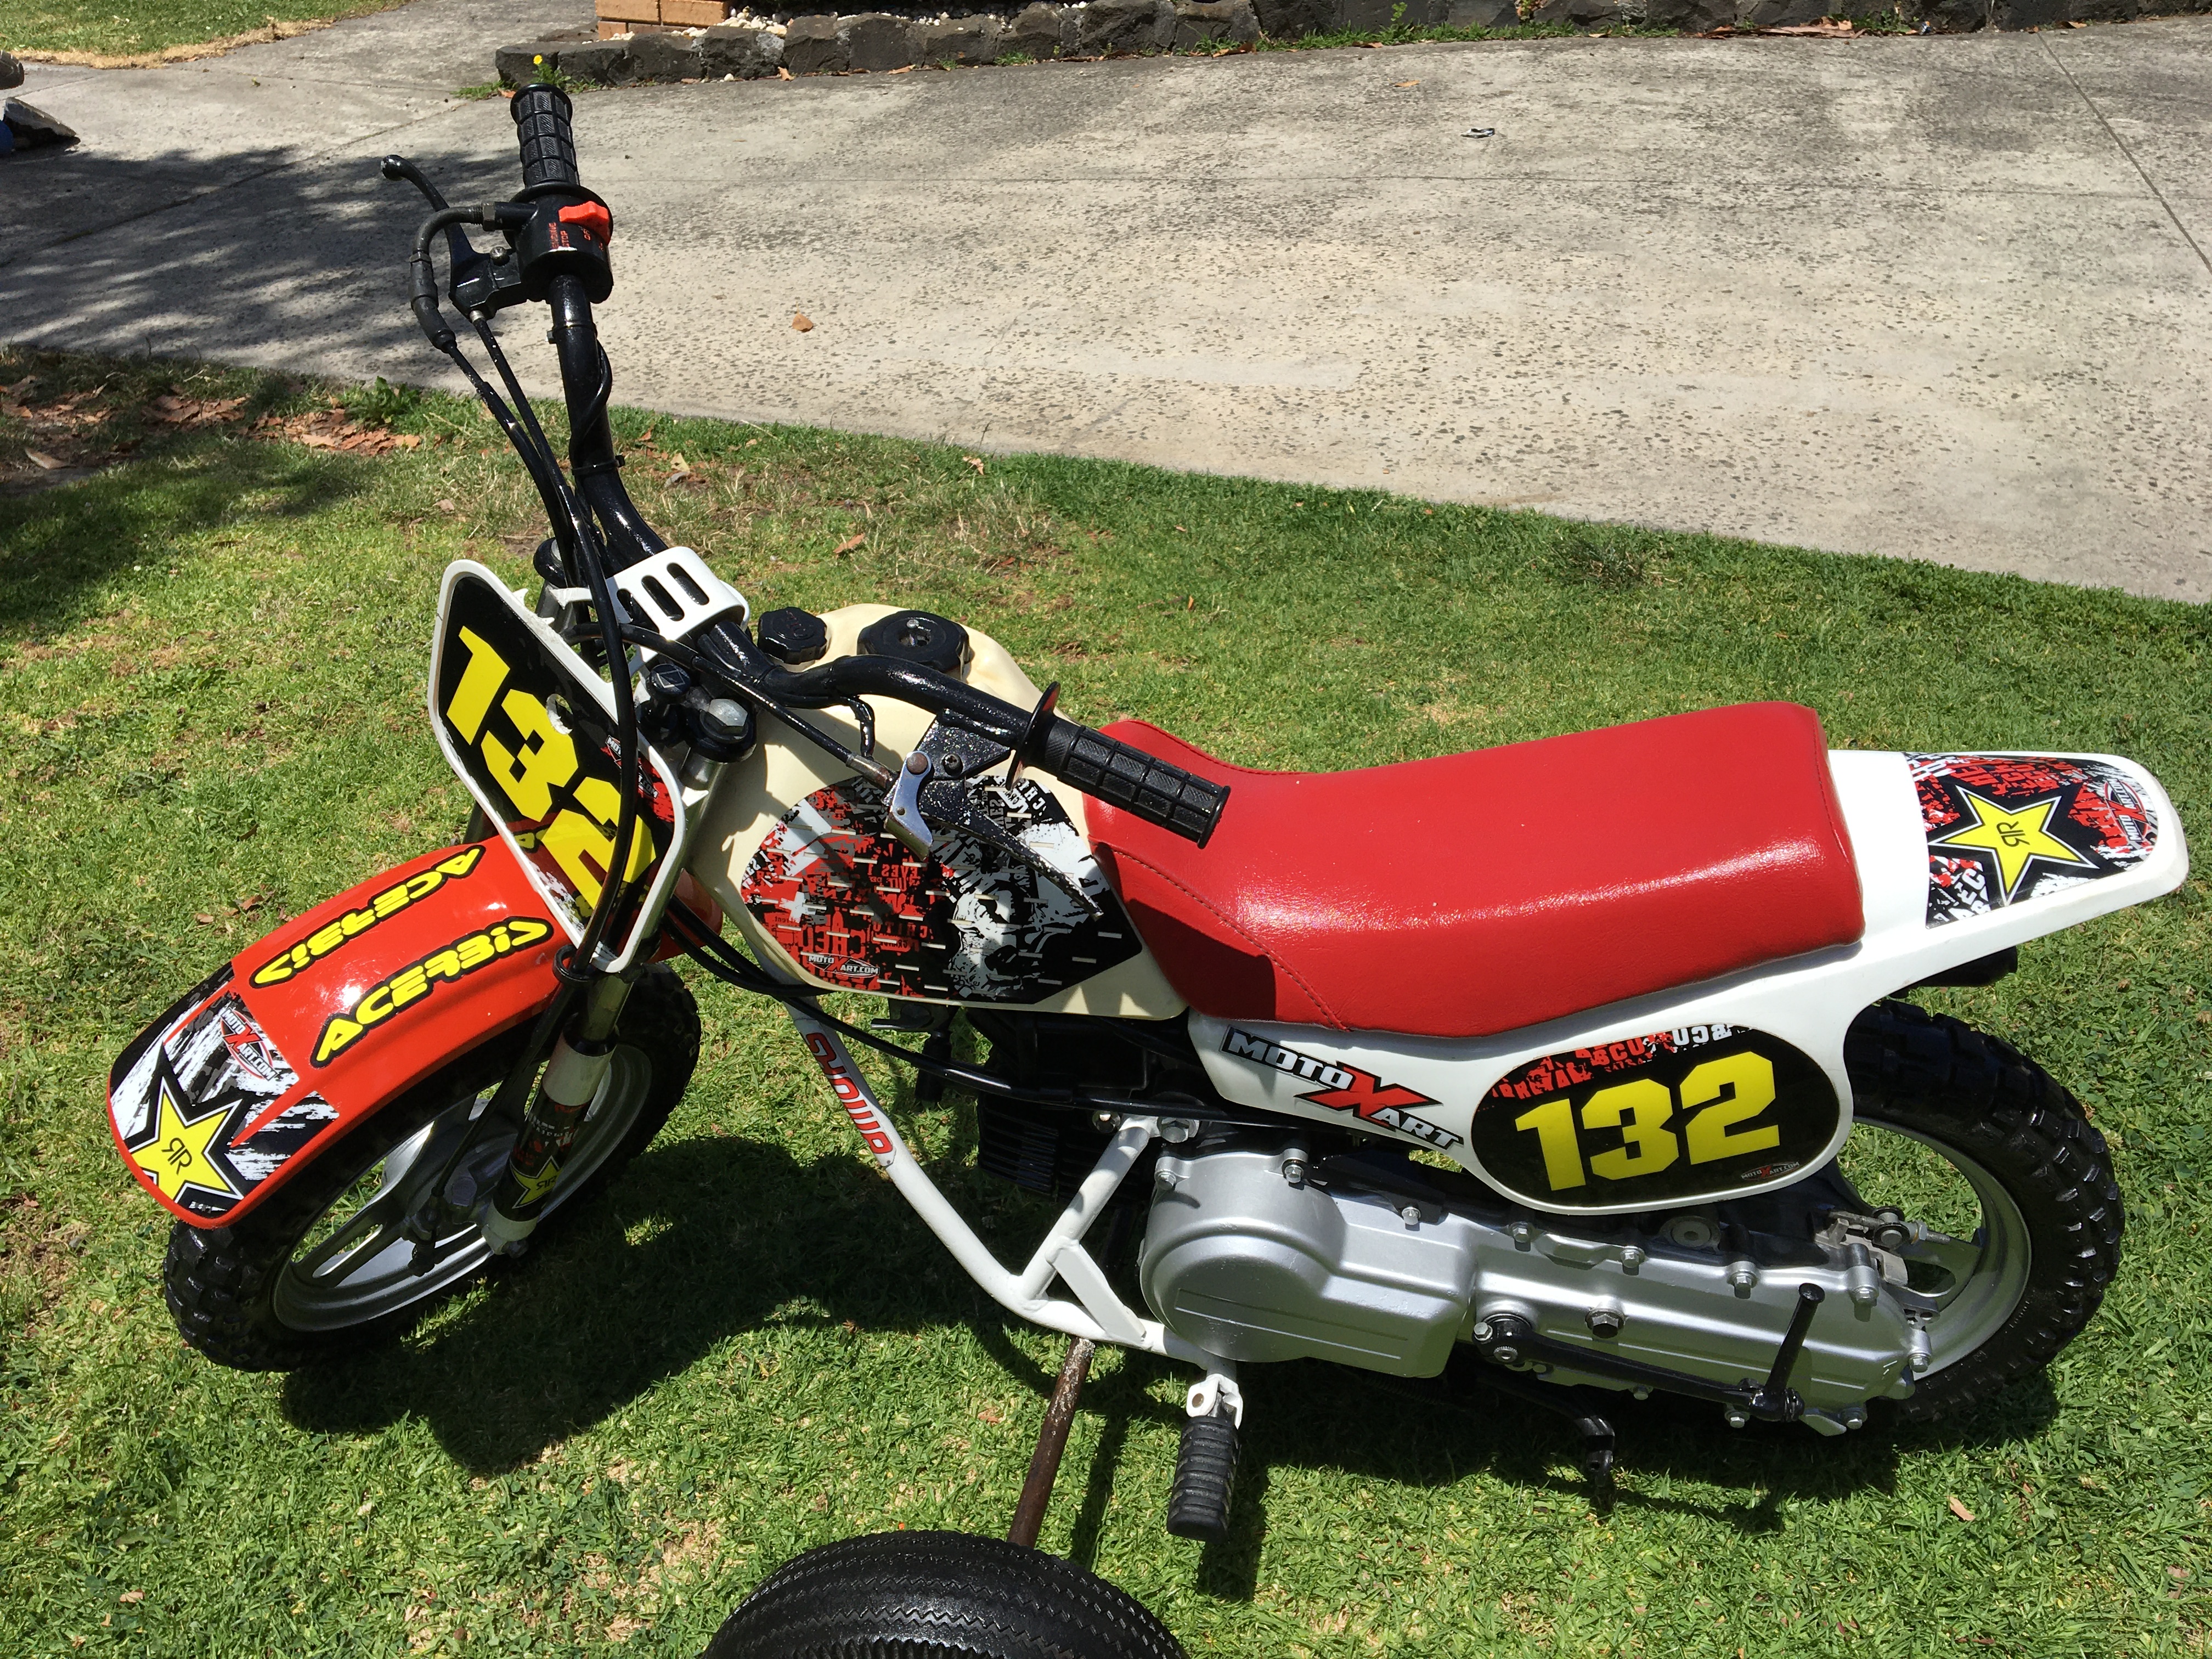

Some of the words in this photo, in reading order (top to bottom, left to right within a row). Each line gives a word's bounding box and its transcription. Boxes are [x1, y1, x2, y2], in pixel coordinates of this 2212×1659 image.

[560, 230, 569, 247] STOP
[446, 625, 656, 910] 132
[1515, 1051, 1781, 1192] 132
